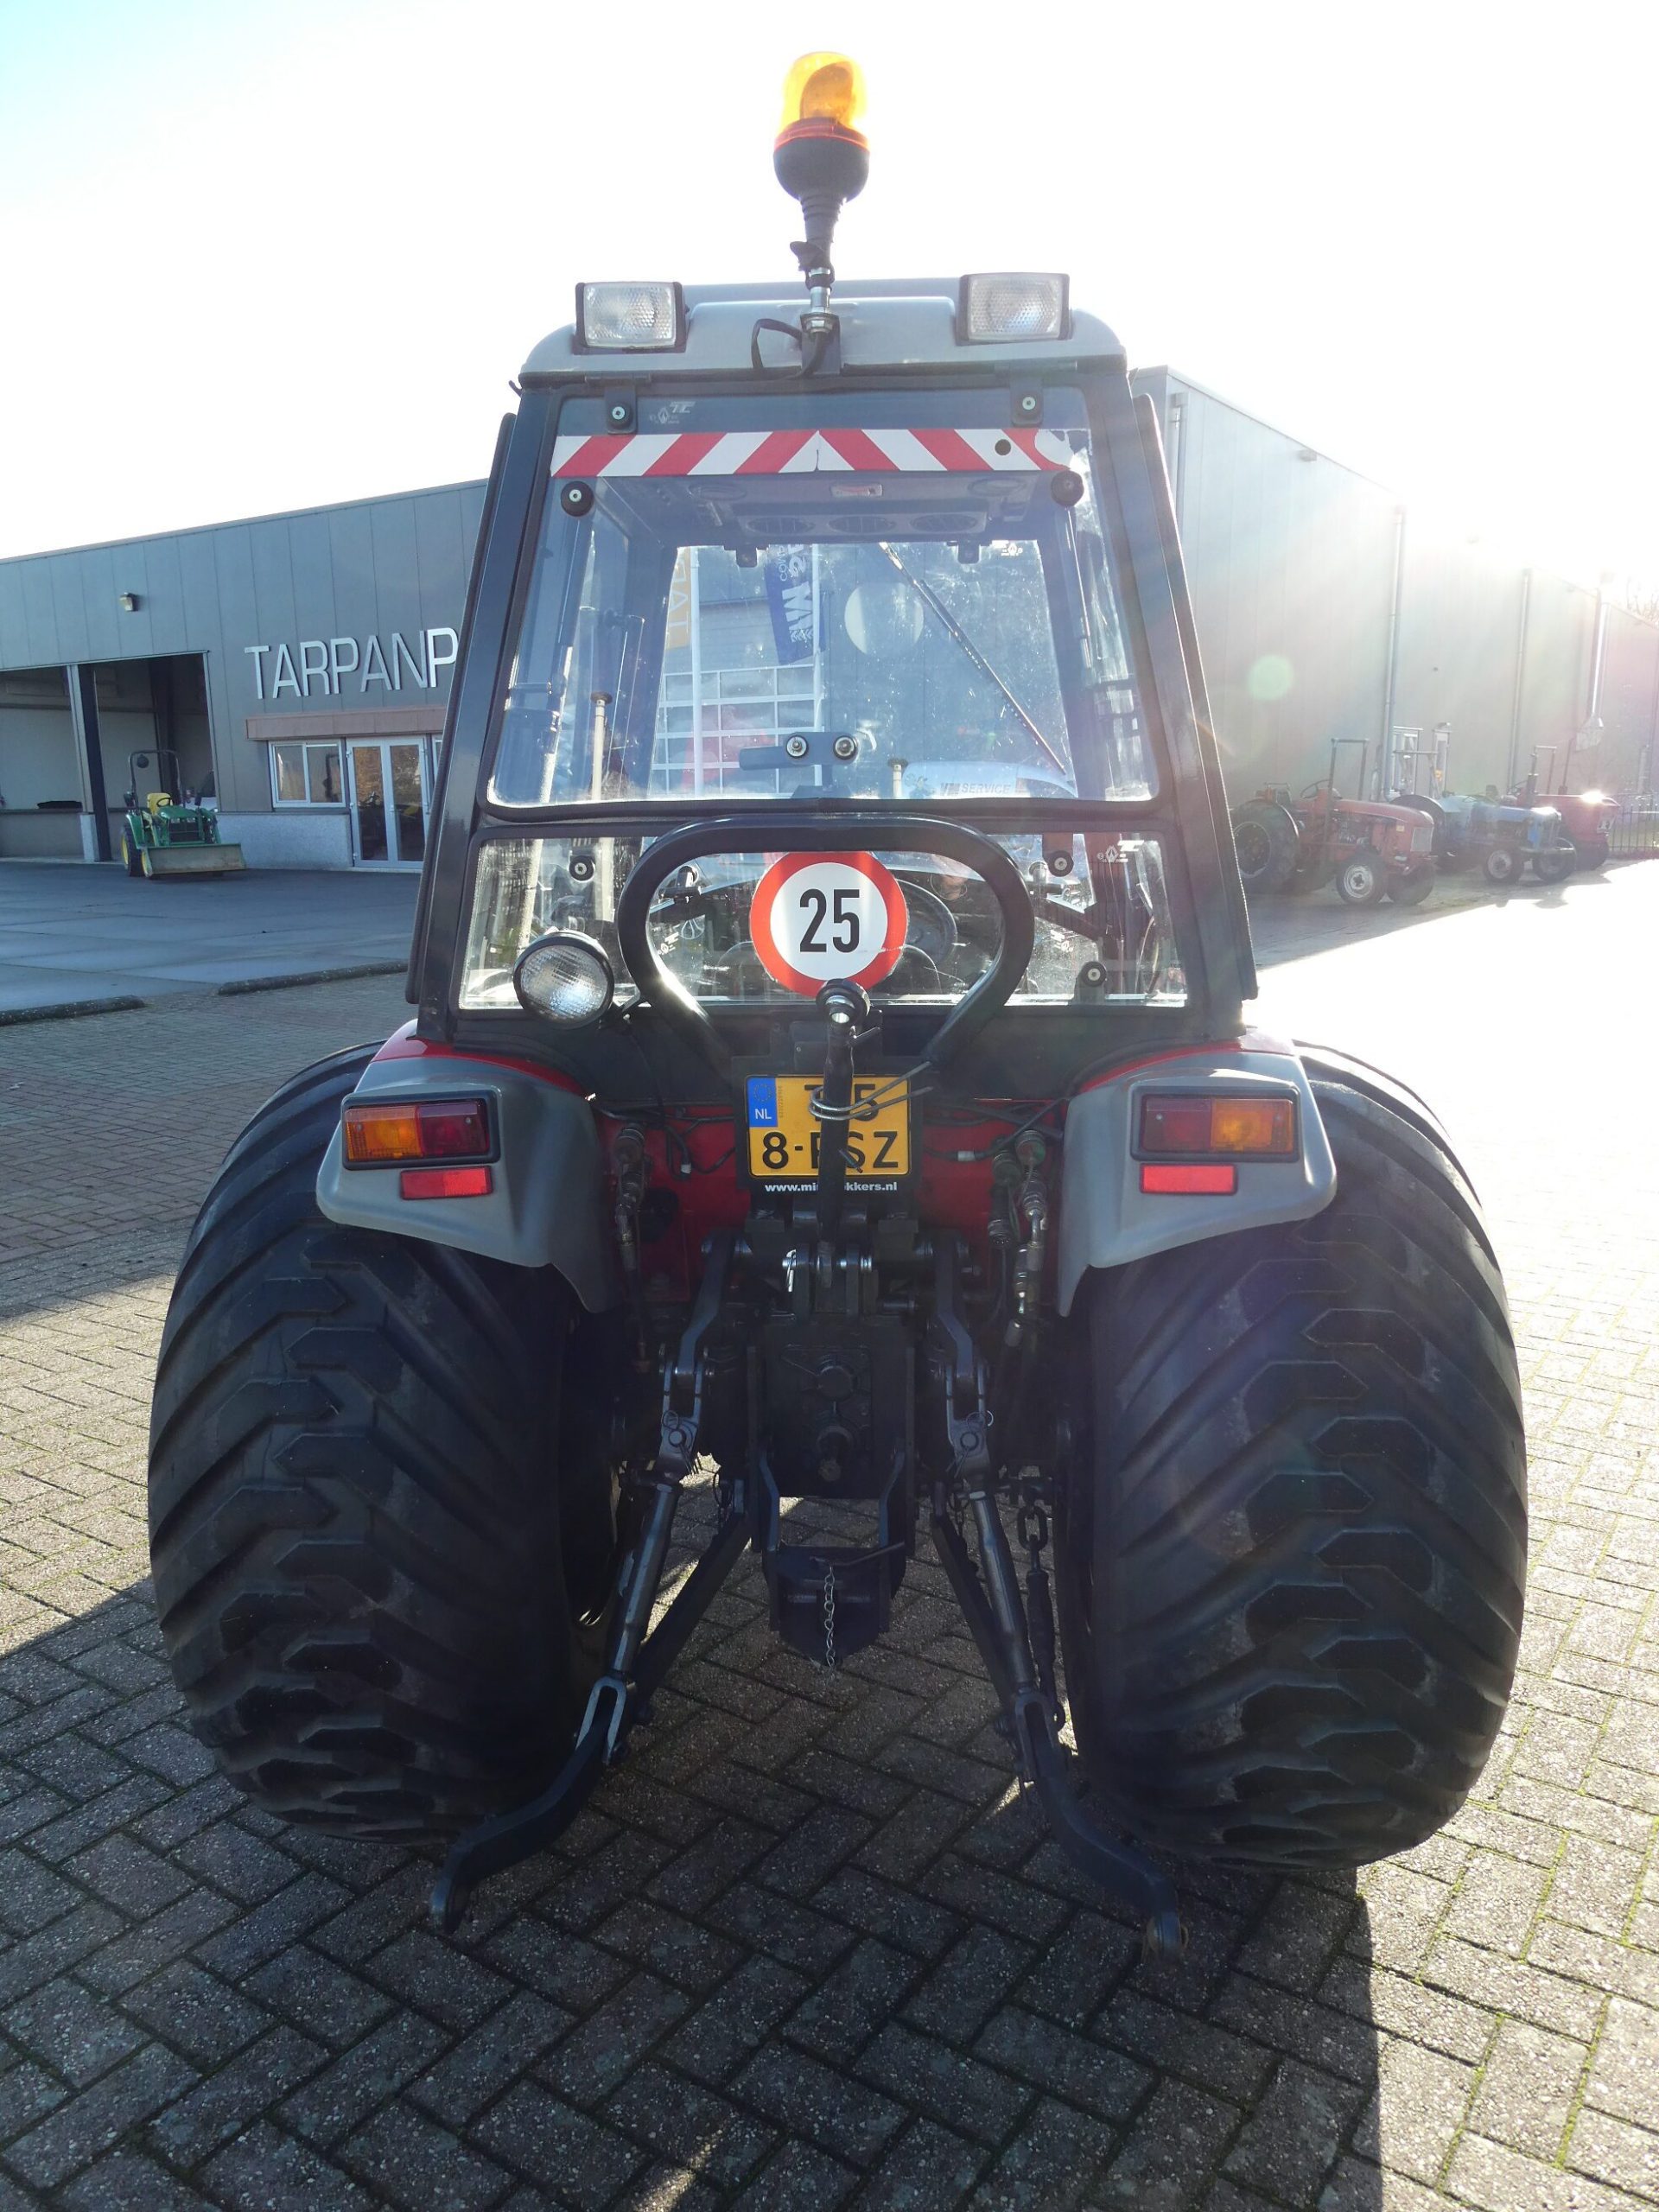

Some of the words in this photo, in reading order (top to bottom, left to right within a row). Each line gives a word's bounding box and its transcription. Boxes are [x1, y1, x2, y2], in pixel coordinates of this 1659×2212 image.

[961, 783, 1012, 794] SERVICE
[799, 888, 860, 953] 25
[754, 1109, 772, 1120] NL
[804, 1084, 879, 1122] T5
